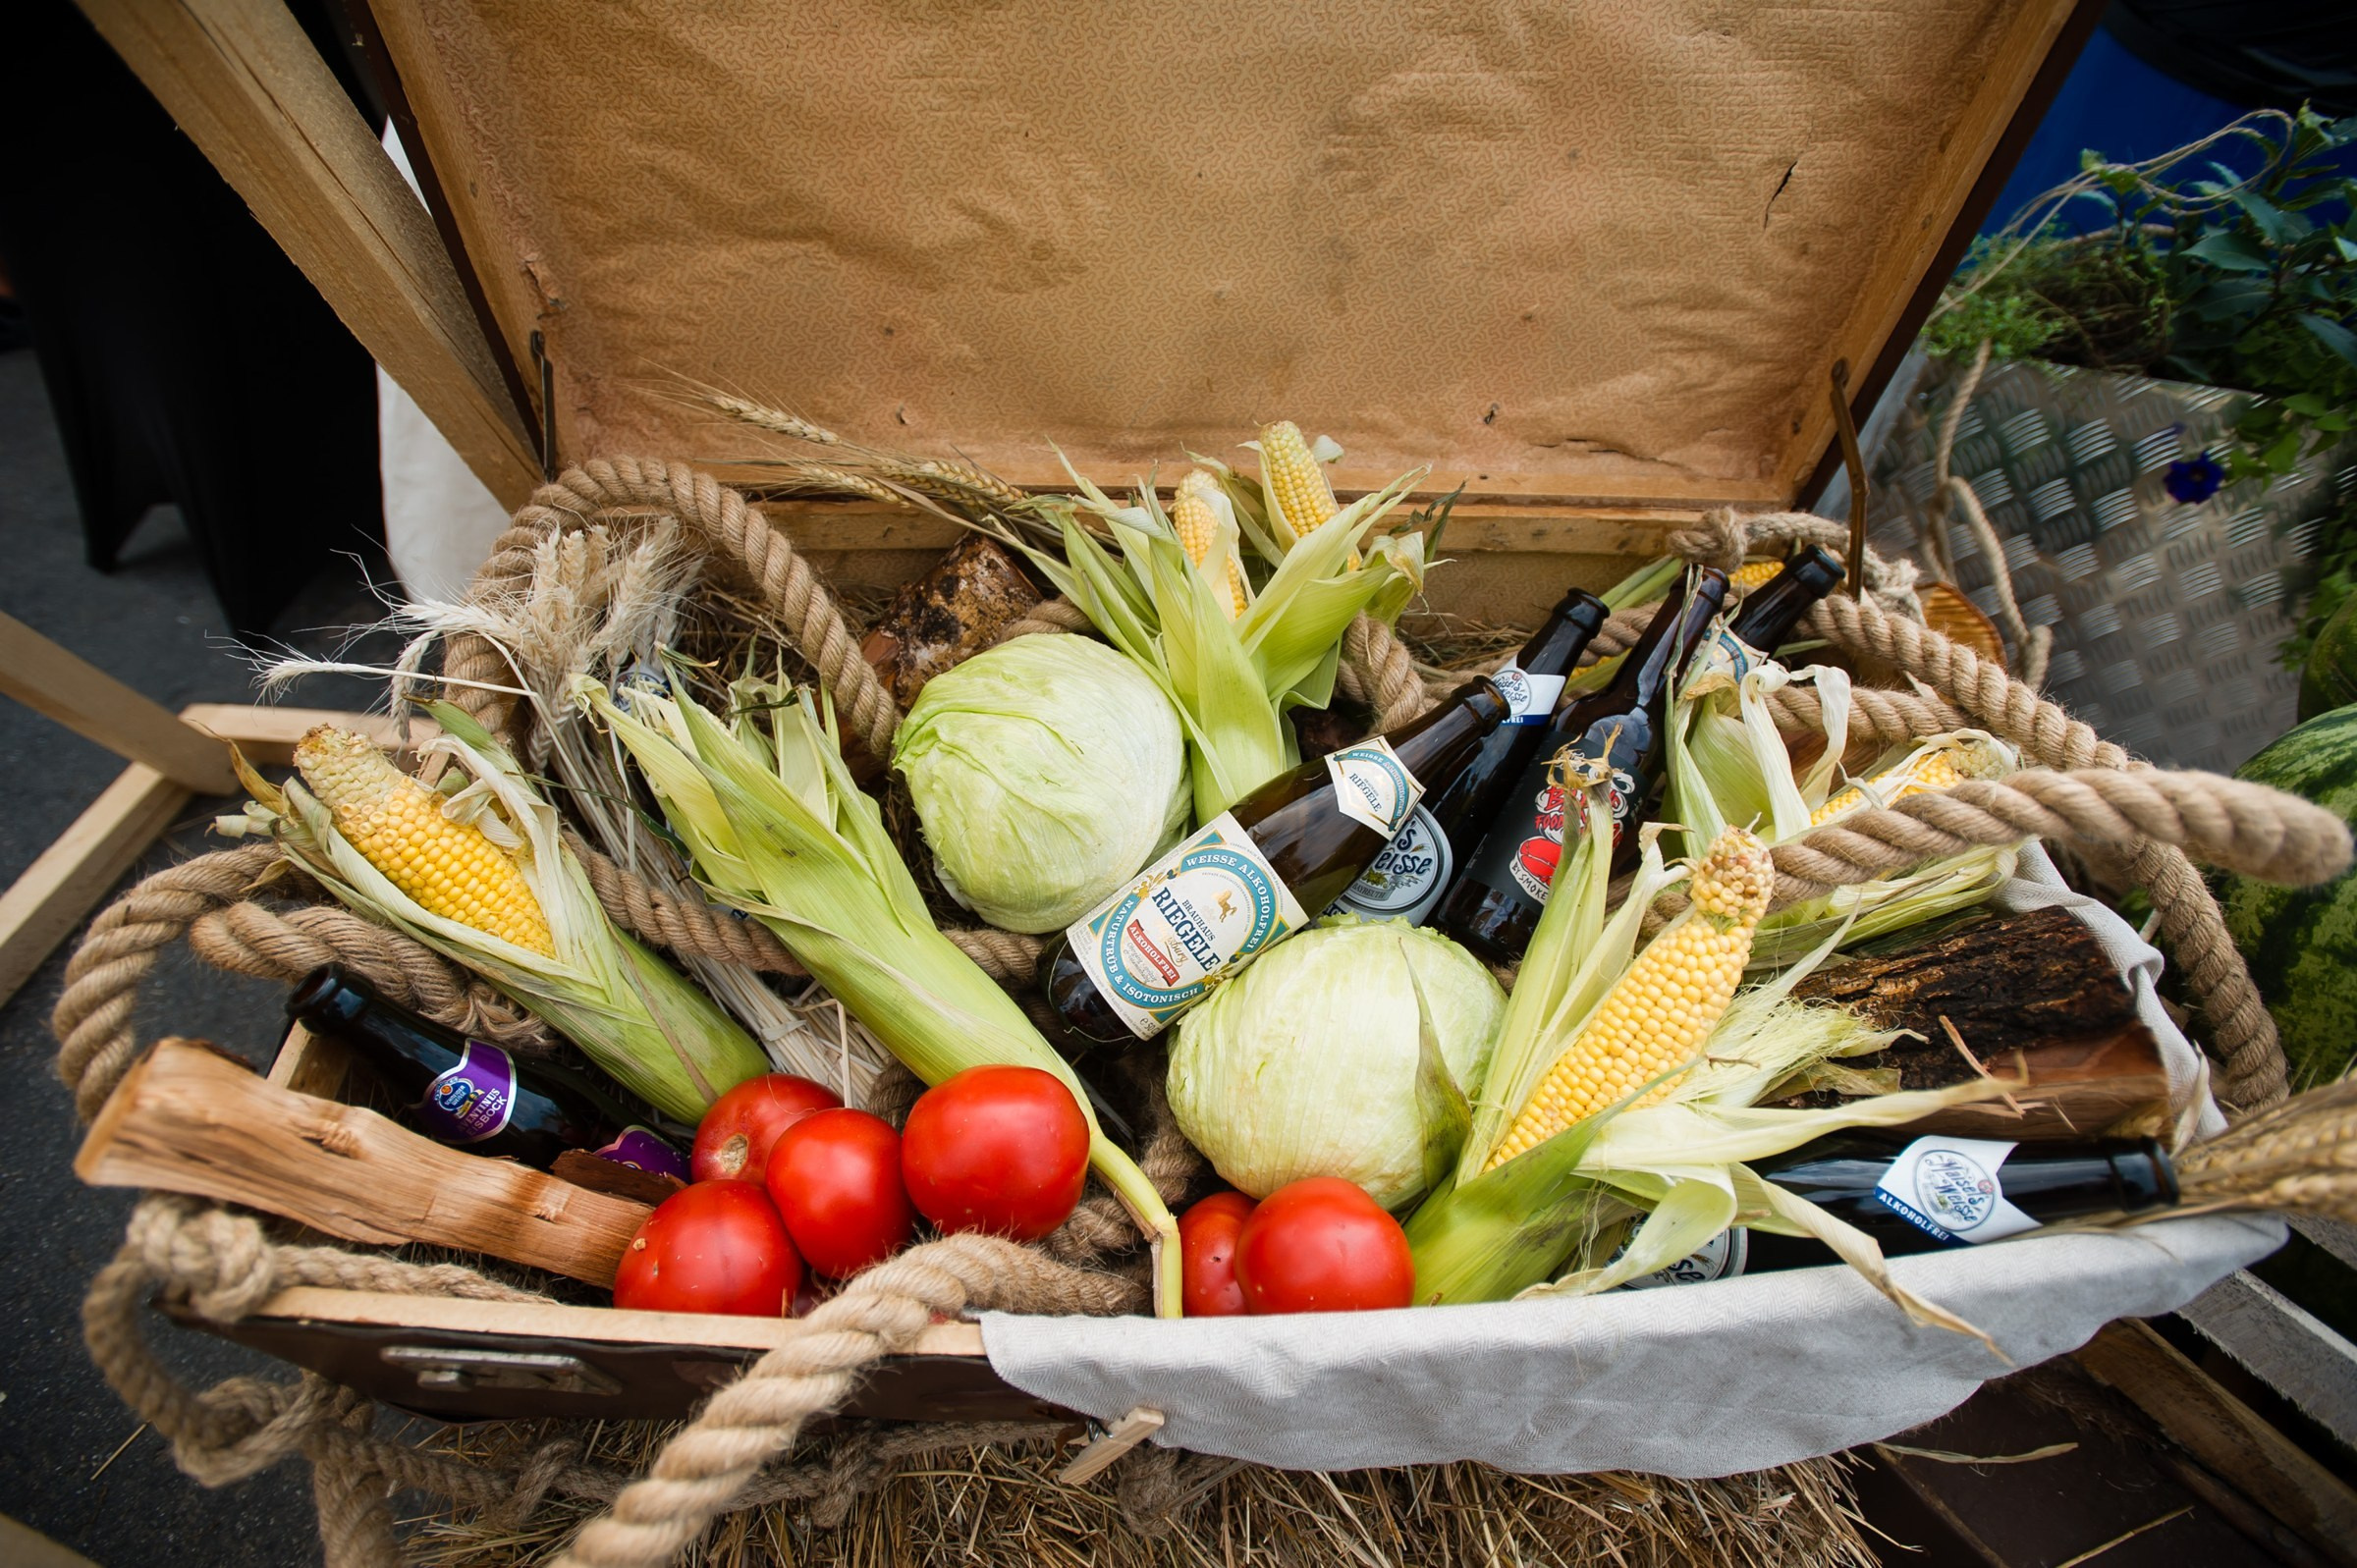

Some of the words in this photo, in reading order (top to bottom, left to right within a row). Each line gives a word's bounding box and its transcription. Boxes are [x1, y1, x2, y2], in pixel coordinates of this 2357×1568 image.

[1352, 752, 1384, 763] WEISSE
[1349, 773, 1382, 812] RIEGELE
[1375, 851, 1432, 875] eisse
[1511, 862, 1520, 875] BY
[1181, 899, 1216, 942] BRAUHAUS
[1186, 854, 1237, 867] WEISSE
[1238, 863, 1271, 950] ALKOHOLFREI
[1103, 899, 1133, 975] NATURTRÜB
[1151, 887, 1221, 972] RIEGELE
[1129, 926, 1177, 980] ALKOHOLFREI
[1115, 975, 1124, 985] &
[1122, 983, 1198, 1003] ISOTONISCH
[1925, 1159, 1989, 1206] Maisel's
[1934, 1180, 1977, 1221] Weisse
[1879, 1193, 1949, 1241] ALKOHOLFREI
